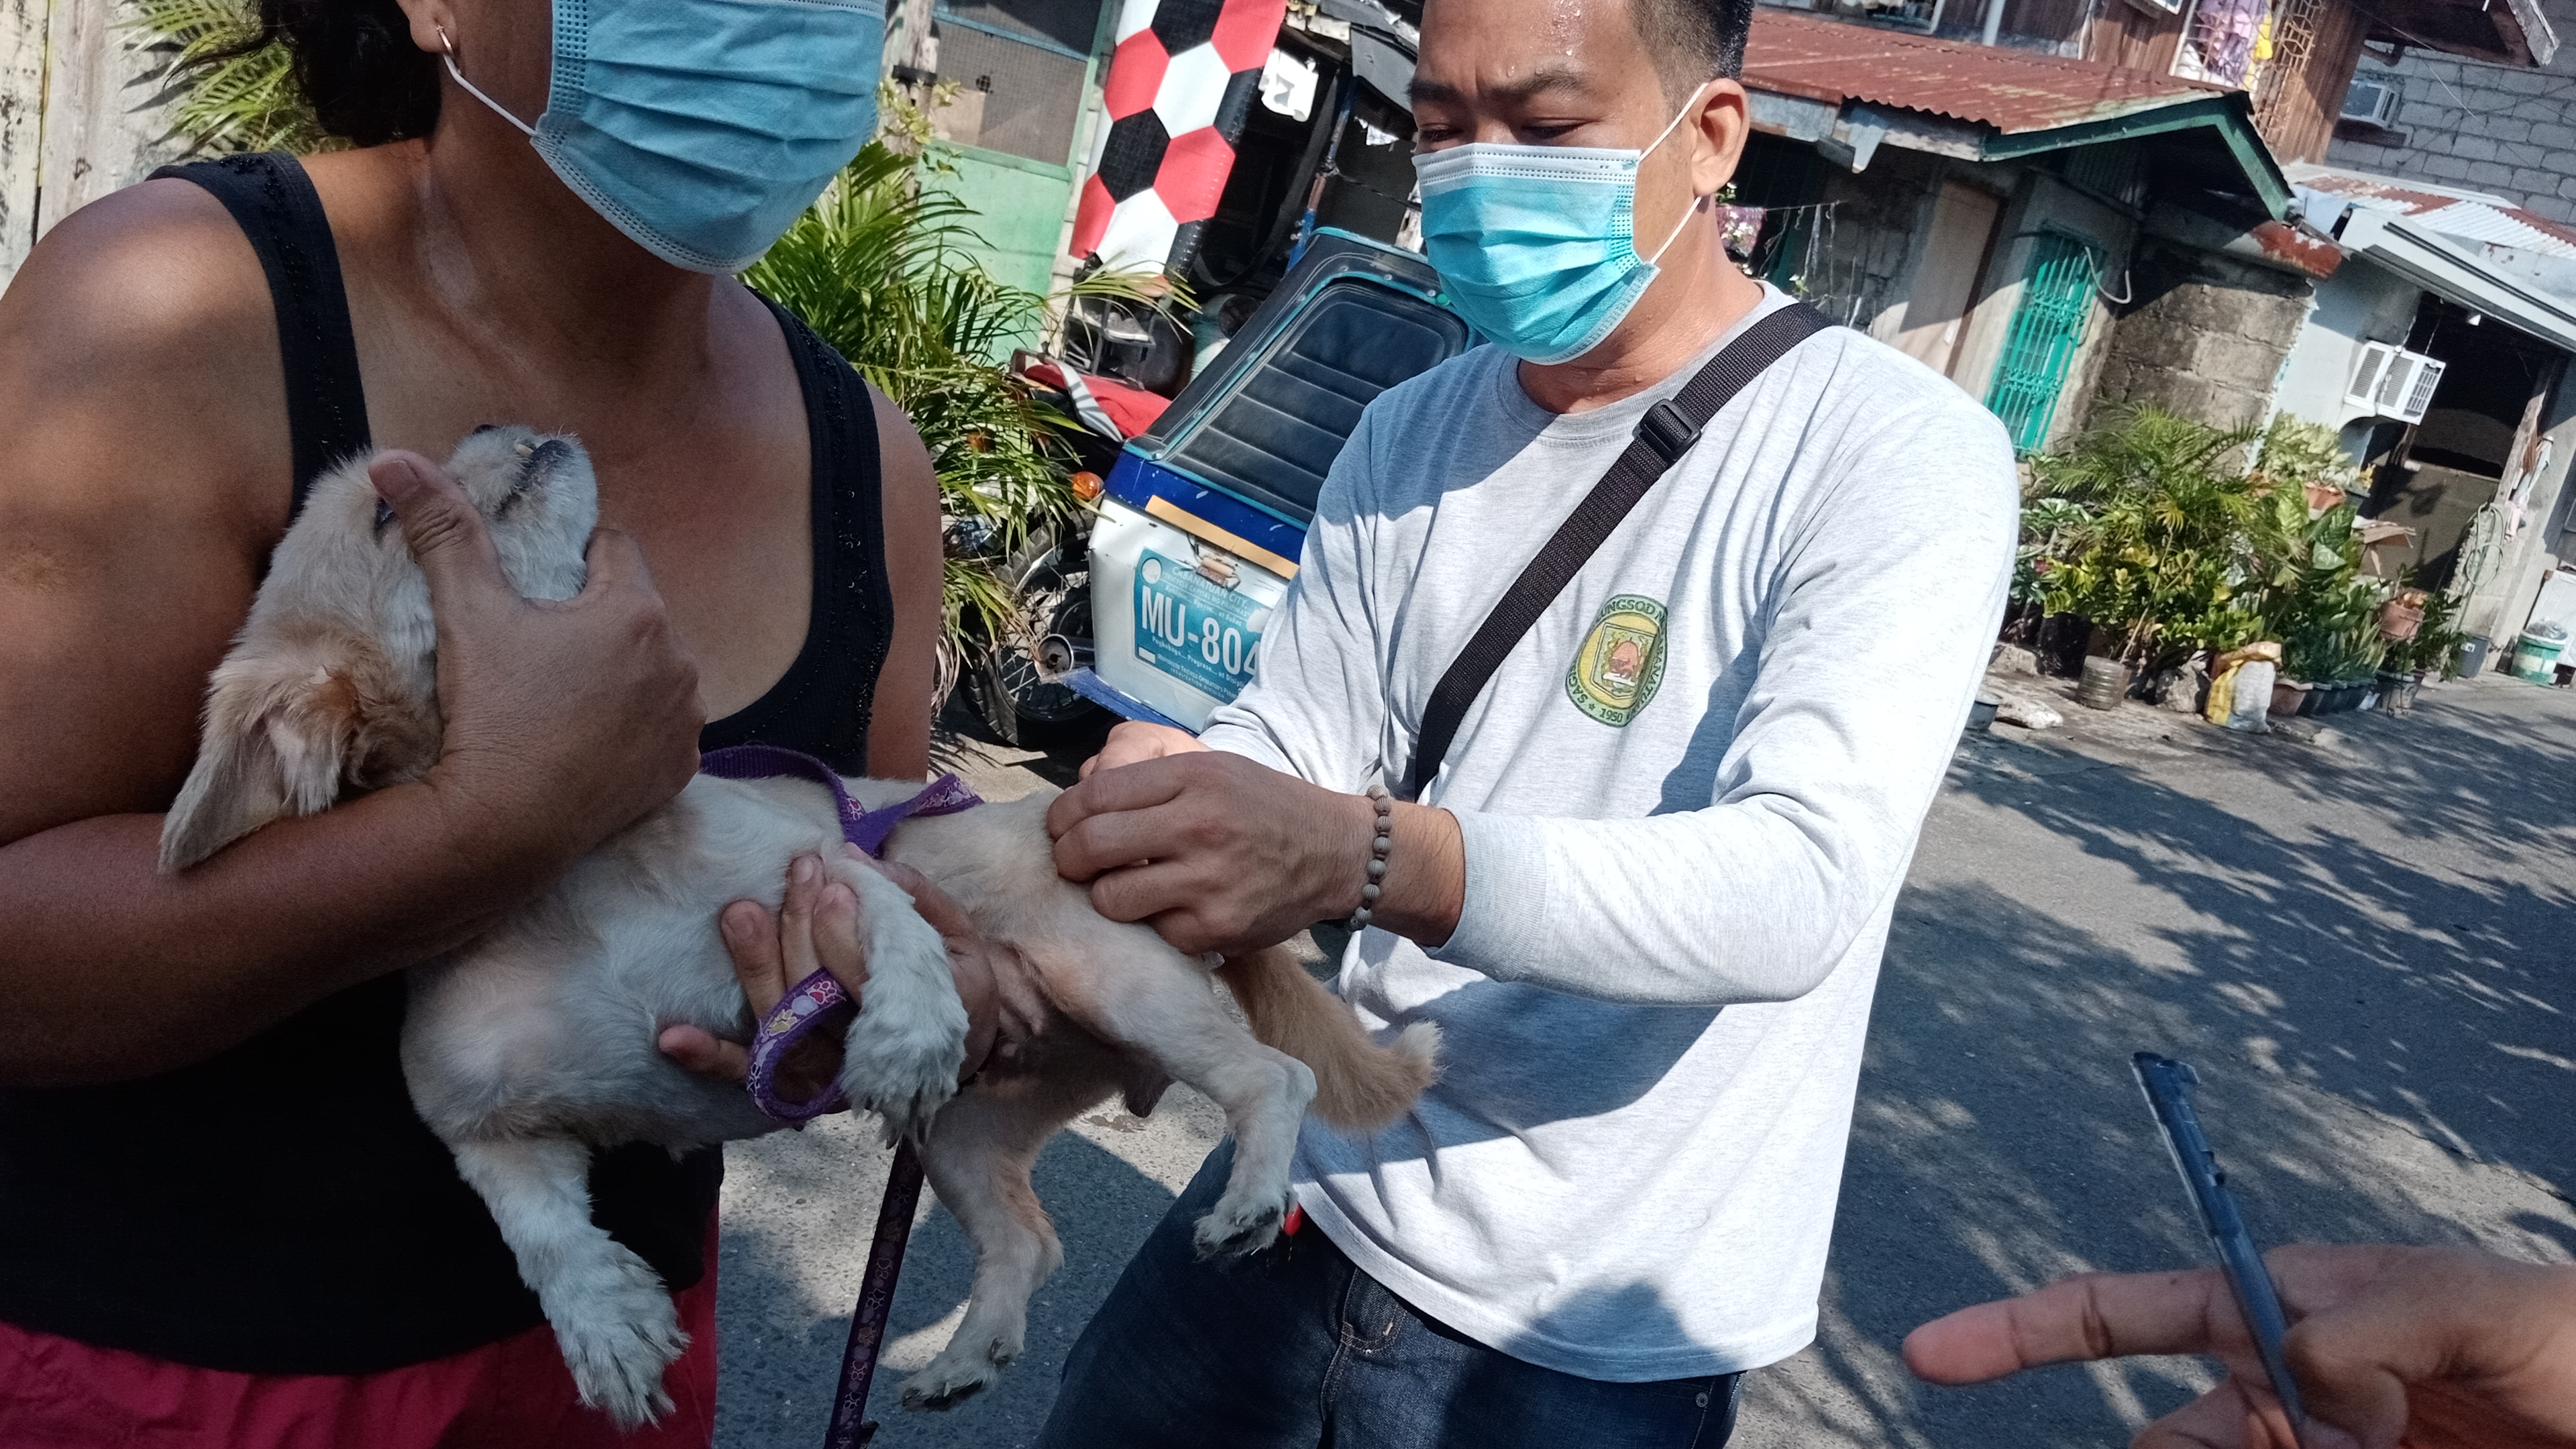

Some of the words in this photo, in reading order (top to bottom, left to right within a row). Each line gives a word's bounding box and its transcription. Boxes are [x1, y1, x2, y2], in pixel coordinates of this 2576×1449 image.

[1172, 566, 1228, 599] CABANATUAN
[1189, 585, 1211, 600] CAPITAL
[1212, 596, 1221, 604] NG
[1599, 708, 1623, 722] 1950
